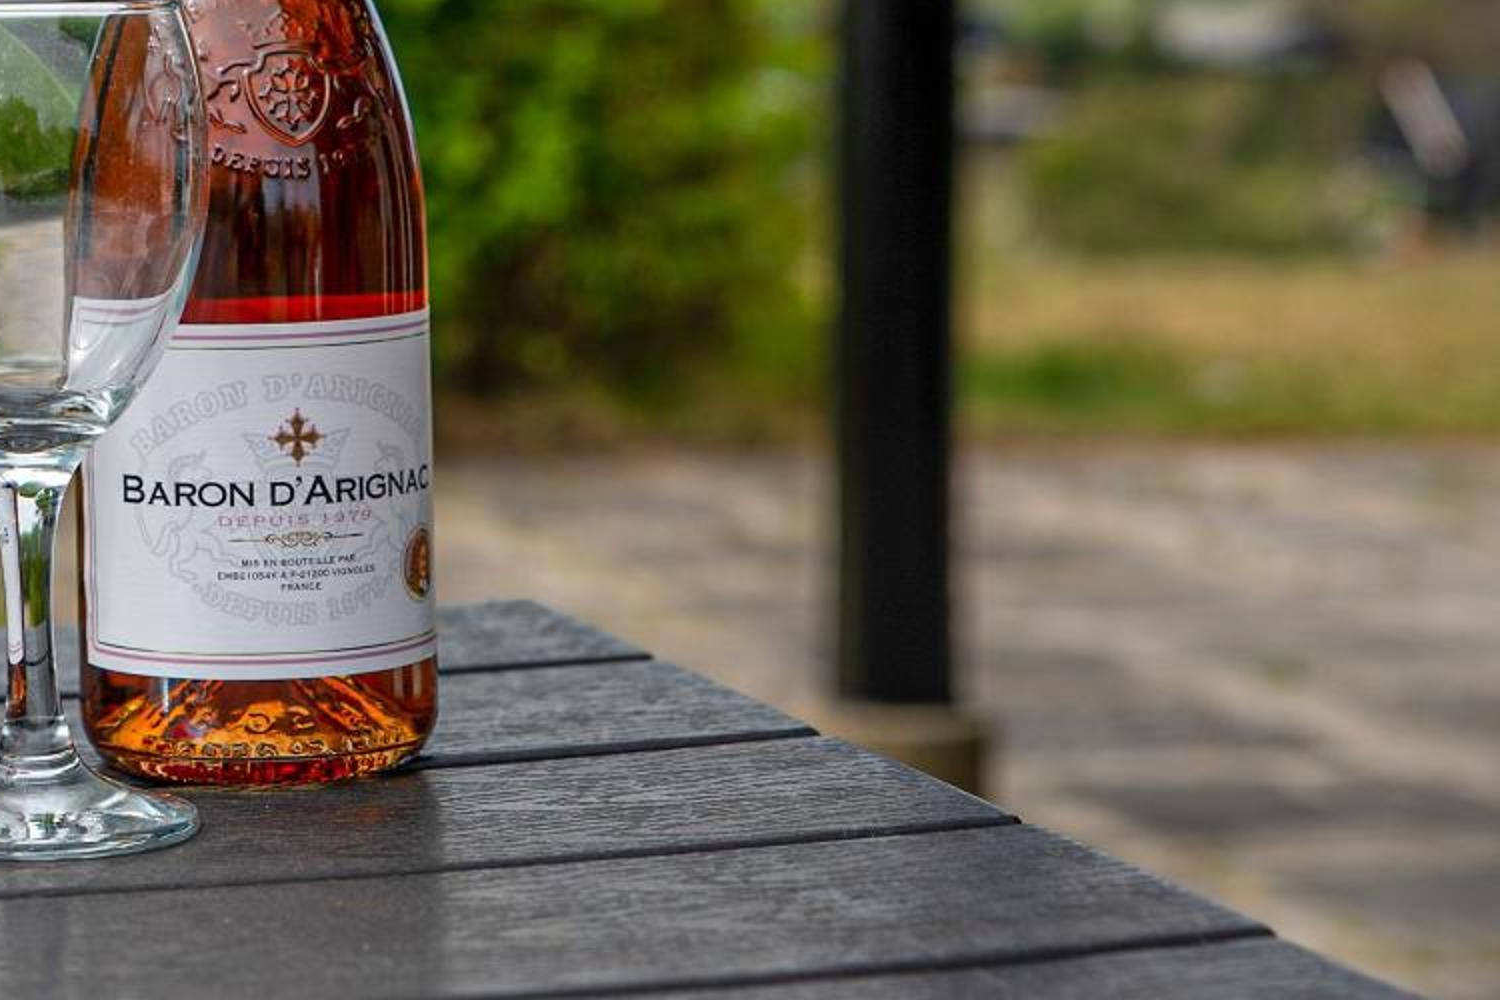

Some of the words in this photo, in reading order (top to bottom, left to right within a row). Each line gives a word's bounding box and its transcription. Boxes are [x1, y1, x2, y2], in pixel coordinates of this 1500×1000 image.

[131, 380, 247, 456] BARON
[122, 474, 255, 508] BARON
[270, 465, 430, 506] D'ARIGNAC
[218, 513, 310, 528] DEPUIS
[323, 509, 373, 525] 1979
[241, 558, 261, 568] MIS
[263, 558, 278, 568] EN
[280, 554, 336, 568] BOUTEILLE
[337, 553, 357, 564] PAR
[281, 581, 324, 592] FRANCE
[203, 582, 317, 626] DEPUIS
